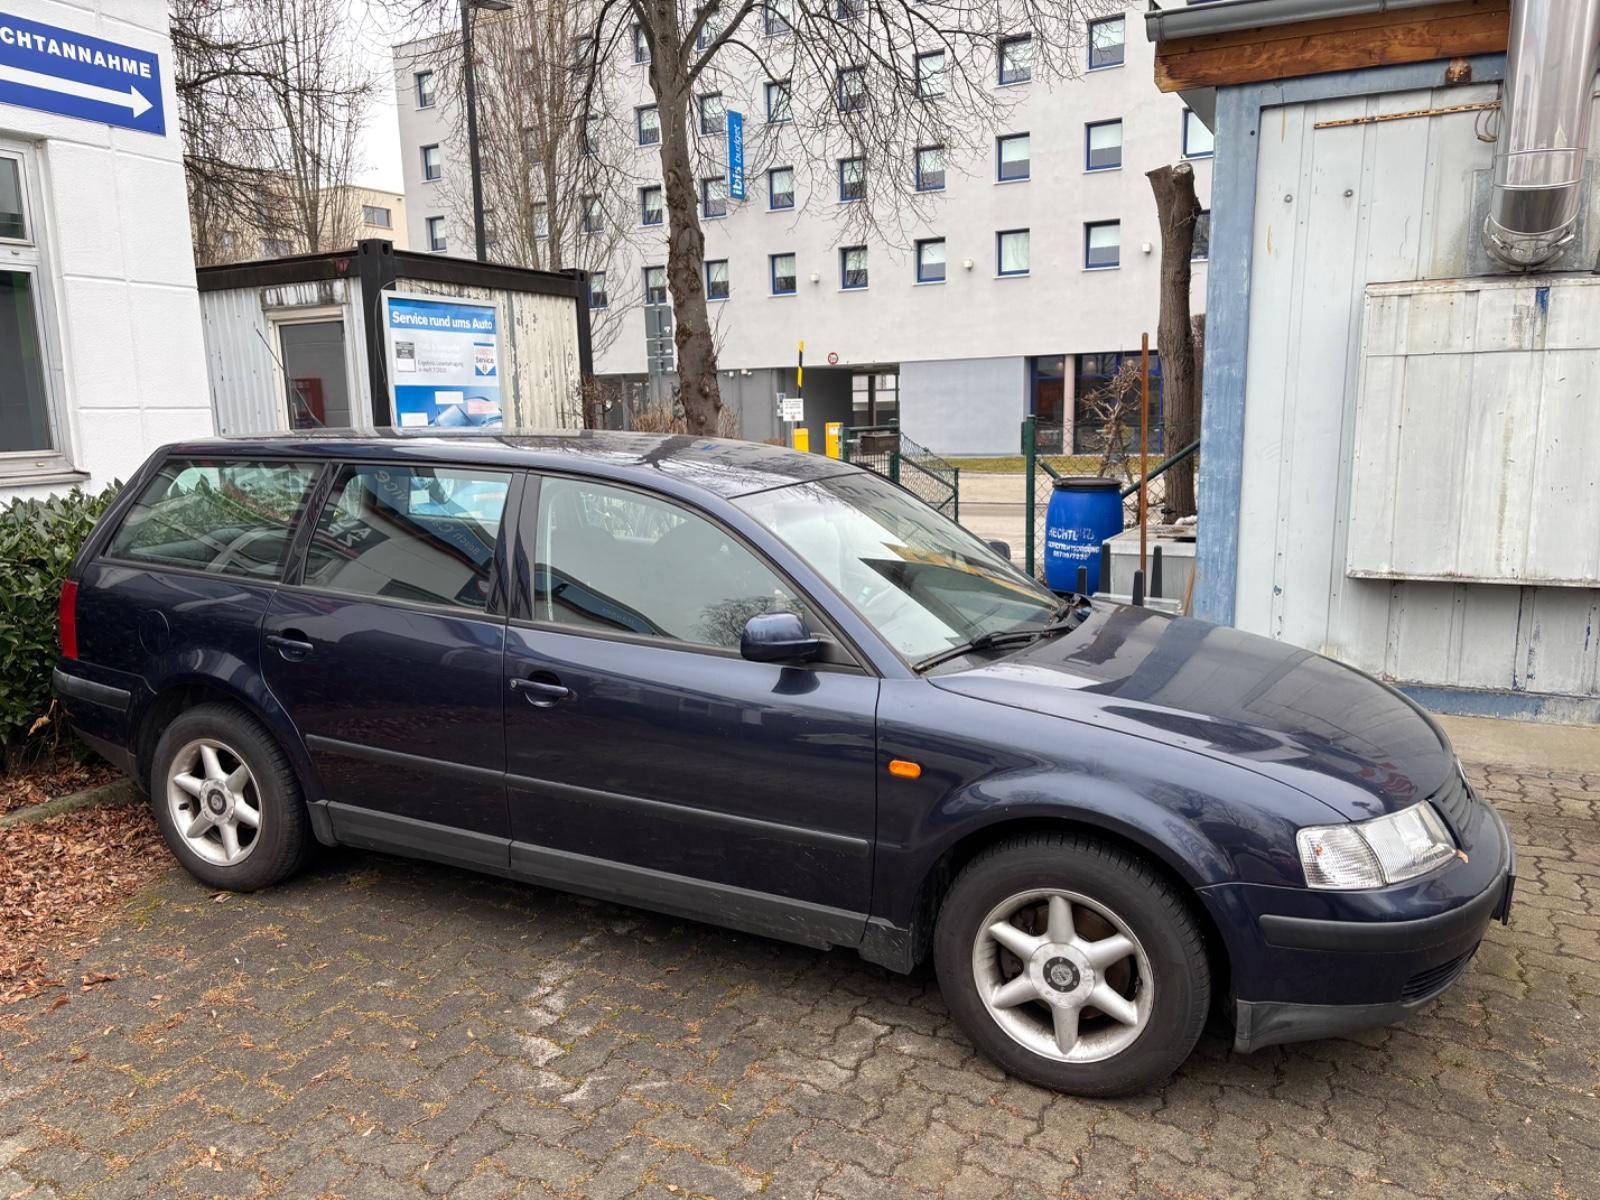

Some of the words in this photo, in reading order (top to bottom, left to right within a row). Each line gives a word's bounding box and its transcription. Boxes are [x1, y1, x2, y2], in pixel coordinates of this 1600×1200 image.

[0, 26, 152, 79] CHTANNAHME
[733, 124, 742, 163] budget
[732, 166, 743, 195] ibis
[392, 311, 428, 325] Service
[429, 315, 450, 328] rund
[452, 320, 471, 329] ums
[472, 318, 493, 330] Auto
[475, 356, 494, 364] Service
